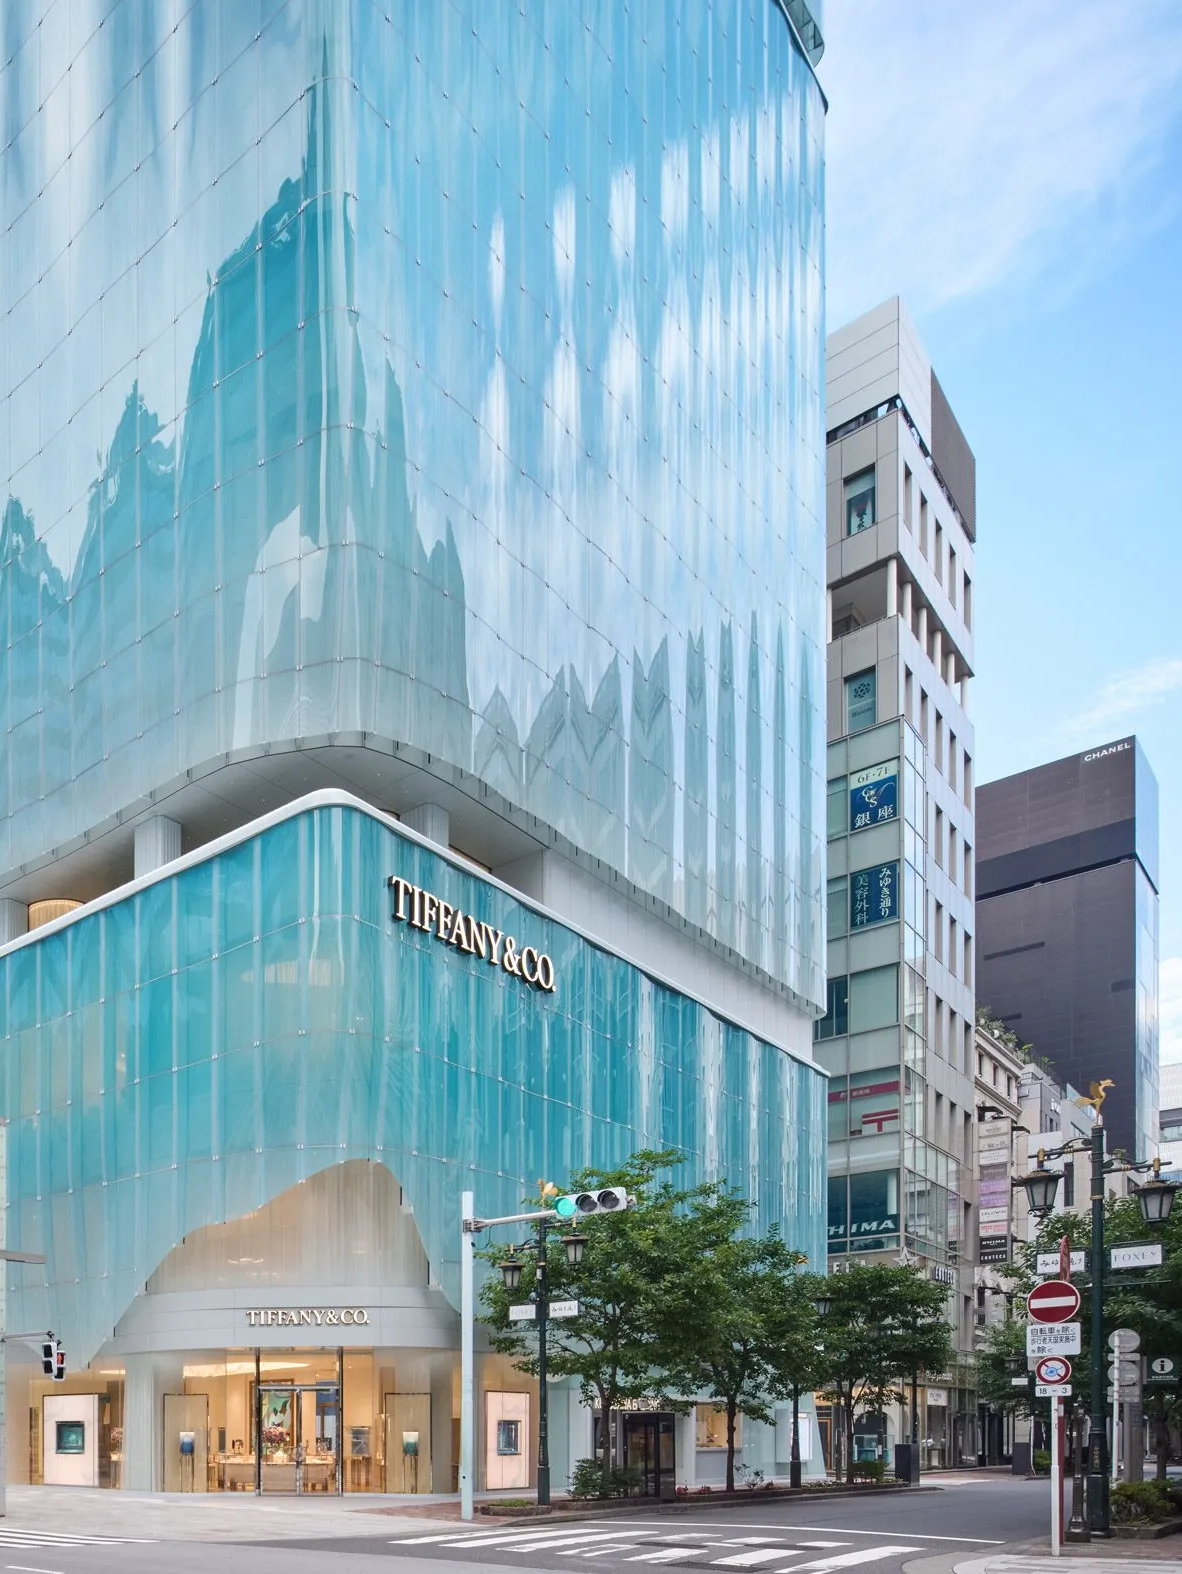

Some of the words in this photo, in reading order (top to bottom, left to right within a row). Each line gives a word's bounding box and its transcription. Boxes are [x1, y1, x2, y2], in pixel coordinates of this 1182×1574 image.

[1084, 742, 1130, 761] CHANEL
[855, 804, 894, 828] 銀座
[854, 874, 869, 926] 美容外科
[879, 867, 892, 918] みゆき通り
[828, 1219, 896, 1236] HIMA
[1040, 1257, 1082, 1267] みゆ通り
[1031, 1326, 1076, 1336] 自転車を除く
[1031, 1335, 1077, 1345] 歩行者天国実施中
